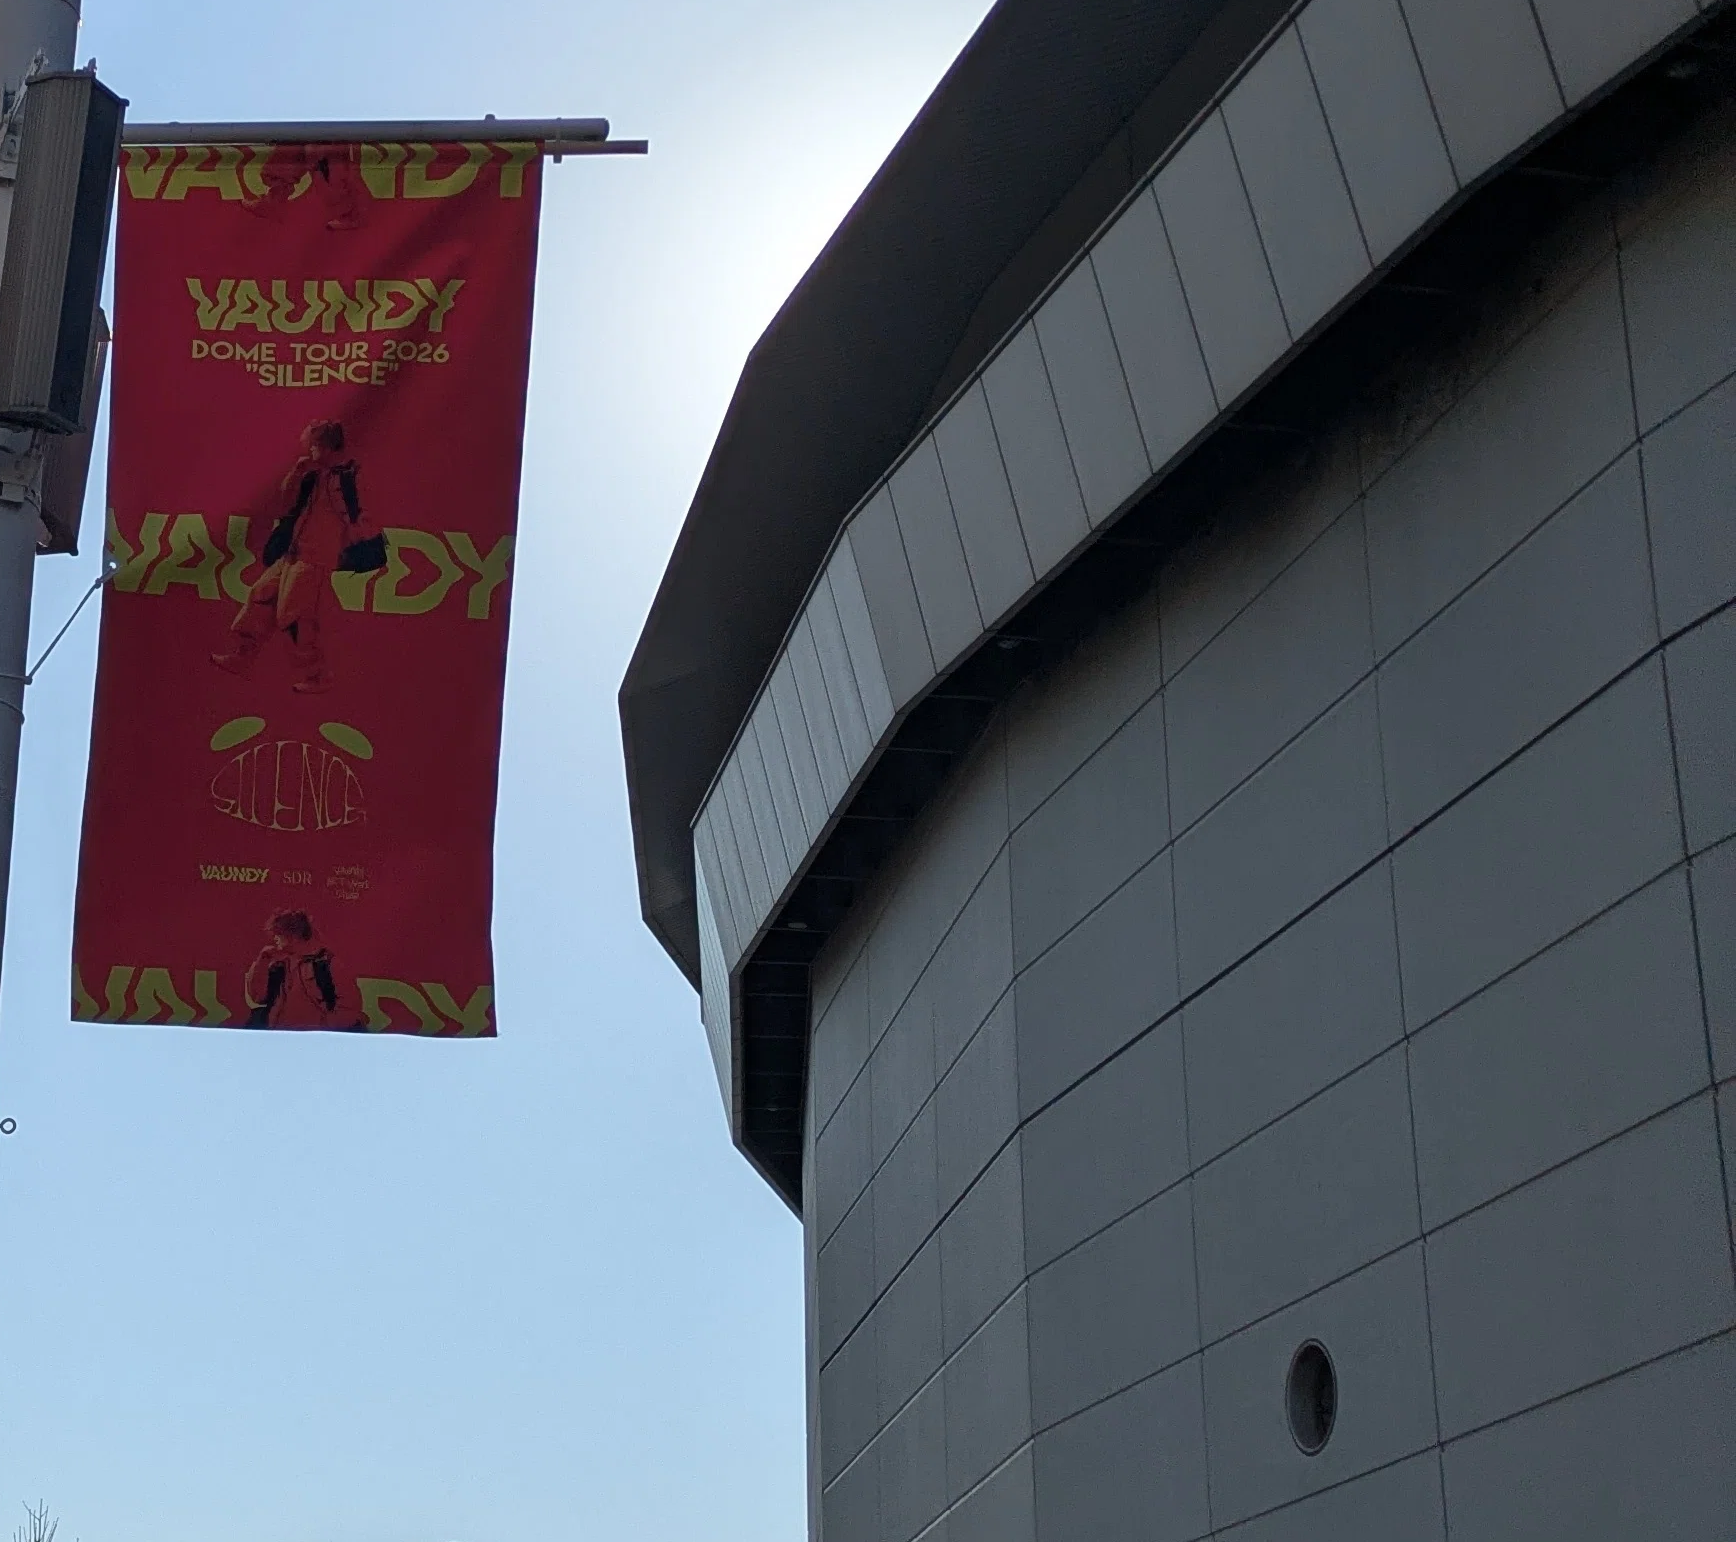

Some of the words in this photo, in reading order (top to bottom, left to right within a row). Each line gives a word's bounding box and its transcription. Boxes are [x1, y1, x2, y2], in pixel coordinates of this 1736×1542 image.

[186, 278, 466, 334] VAUNDY
[192, 339, 277, 362] DOME
[290, 341, 369, 362] TOUR
[382, 339, 450, 364] 2026
[199, 864, 270, 884] VAUNDY
[283, 870, 312, 885] SDR
